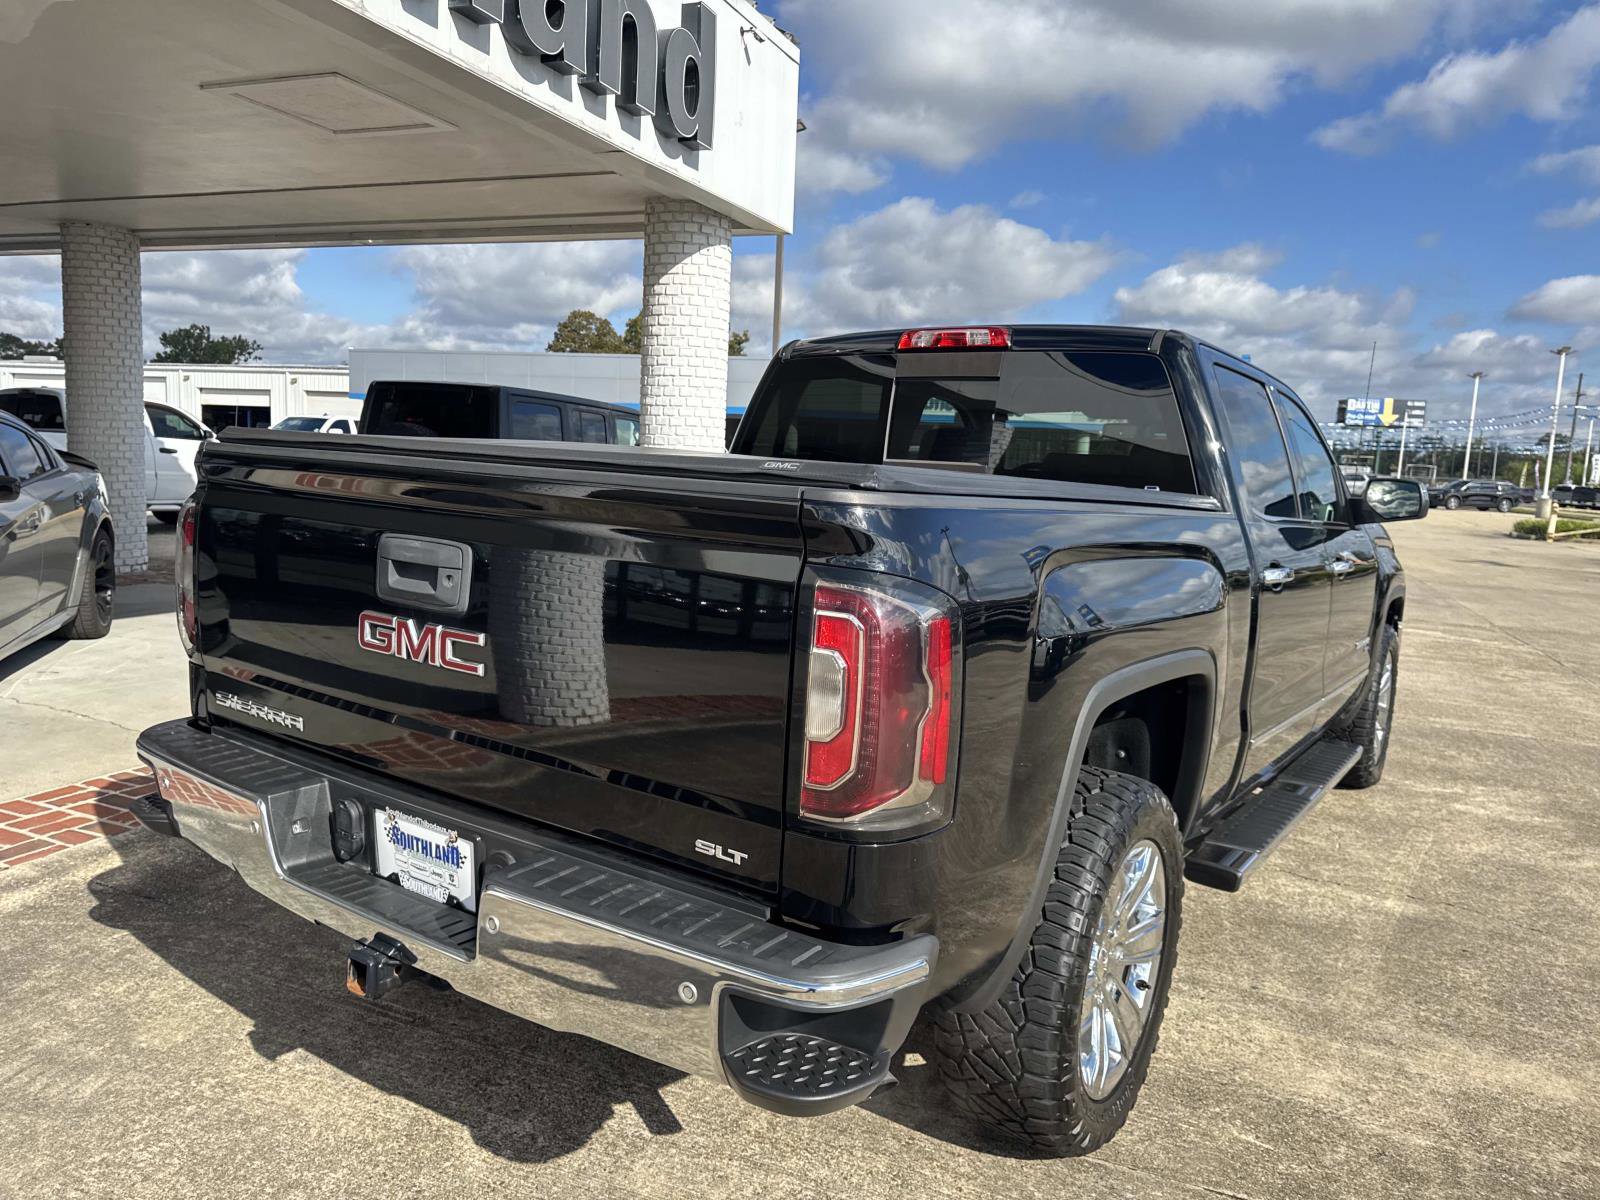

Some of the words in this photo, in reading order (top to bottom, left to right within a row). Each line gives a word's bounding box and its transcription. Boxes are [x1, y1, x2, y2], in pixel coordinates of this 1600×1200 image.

[448, 0, 716, 150] and
[763, 461, 800, 469] GMC
[358, 609, 486, 677] GMC
[215, 690, 304, 732] SIERRA
[391, 824, 460, 870] SOUTHLAND
[694, 838, 749, 866] SLT
